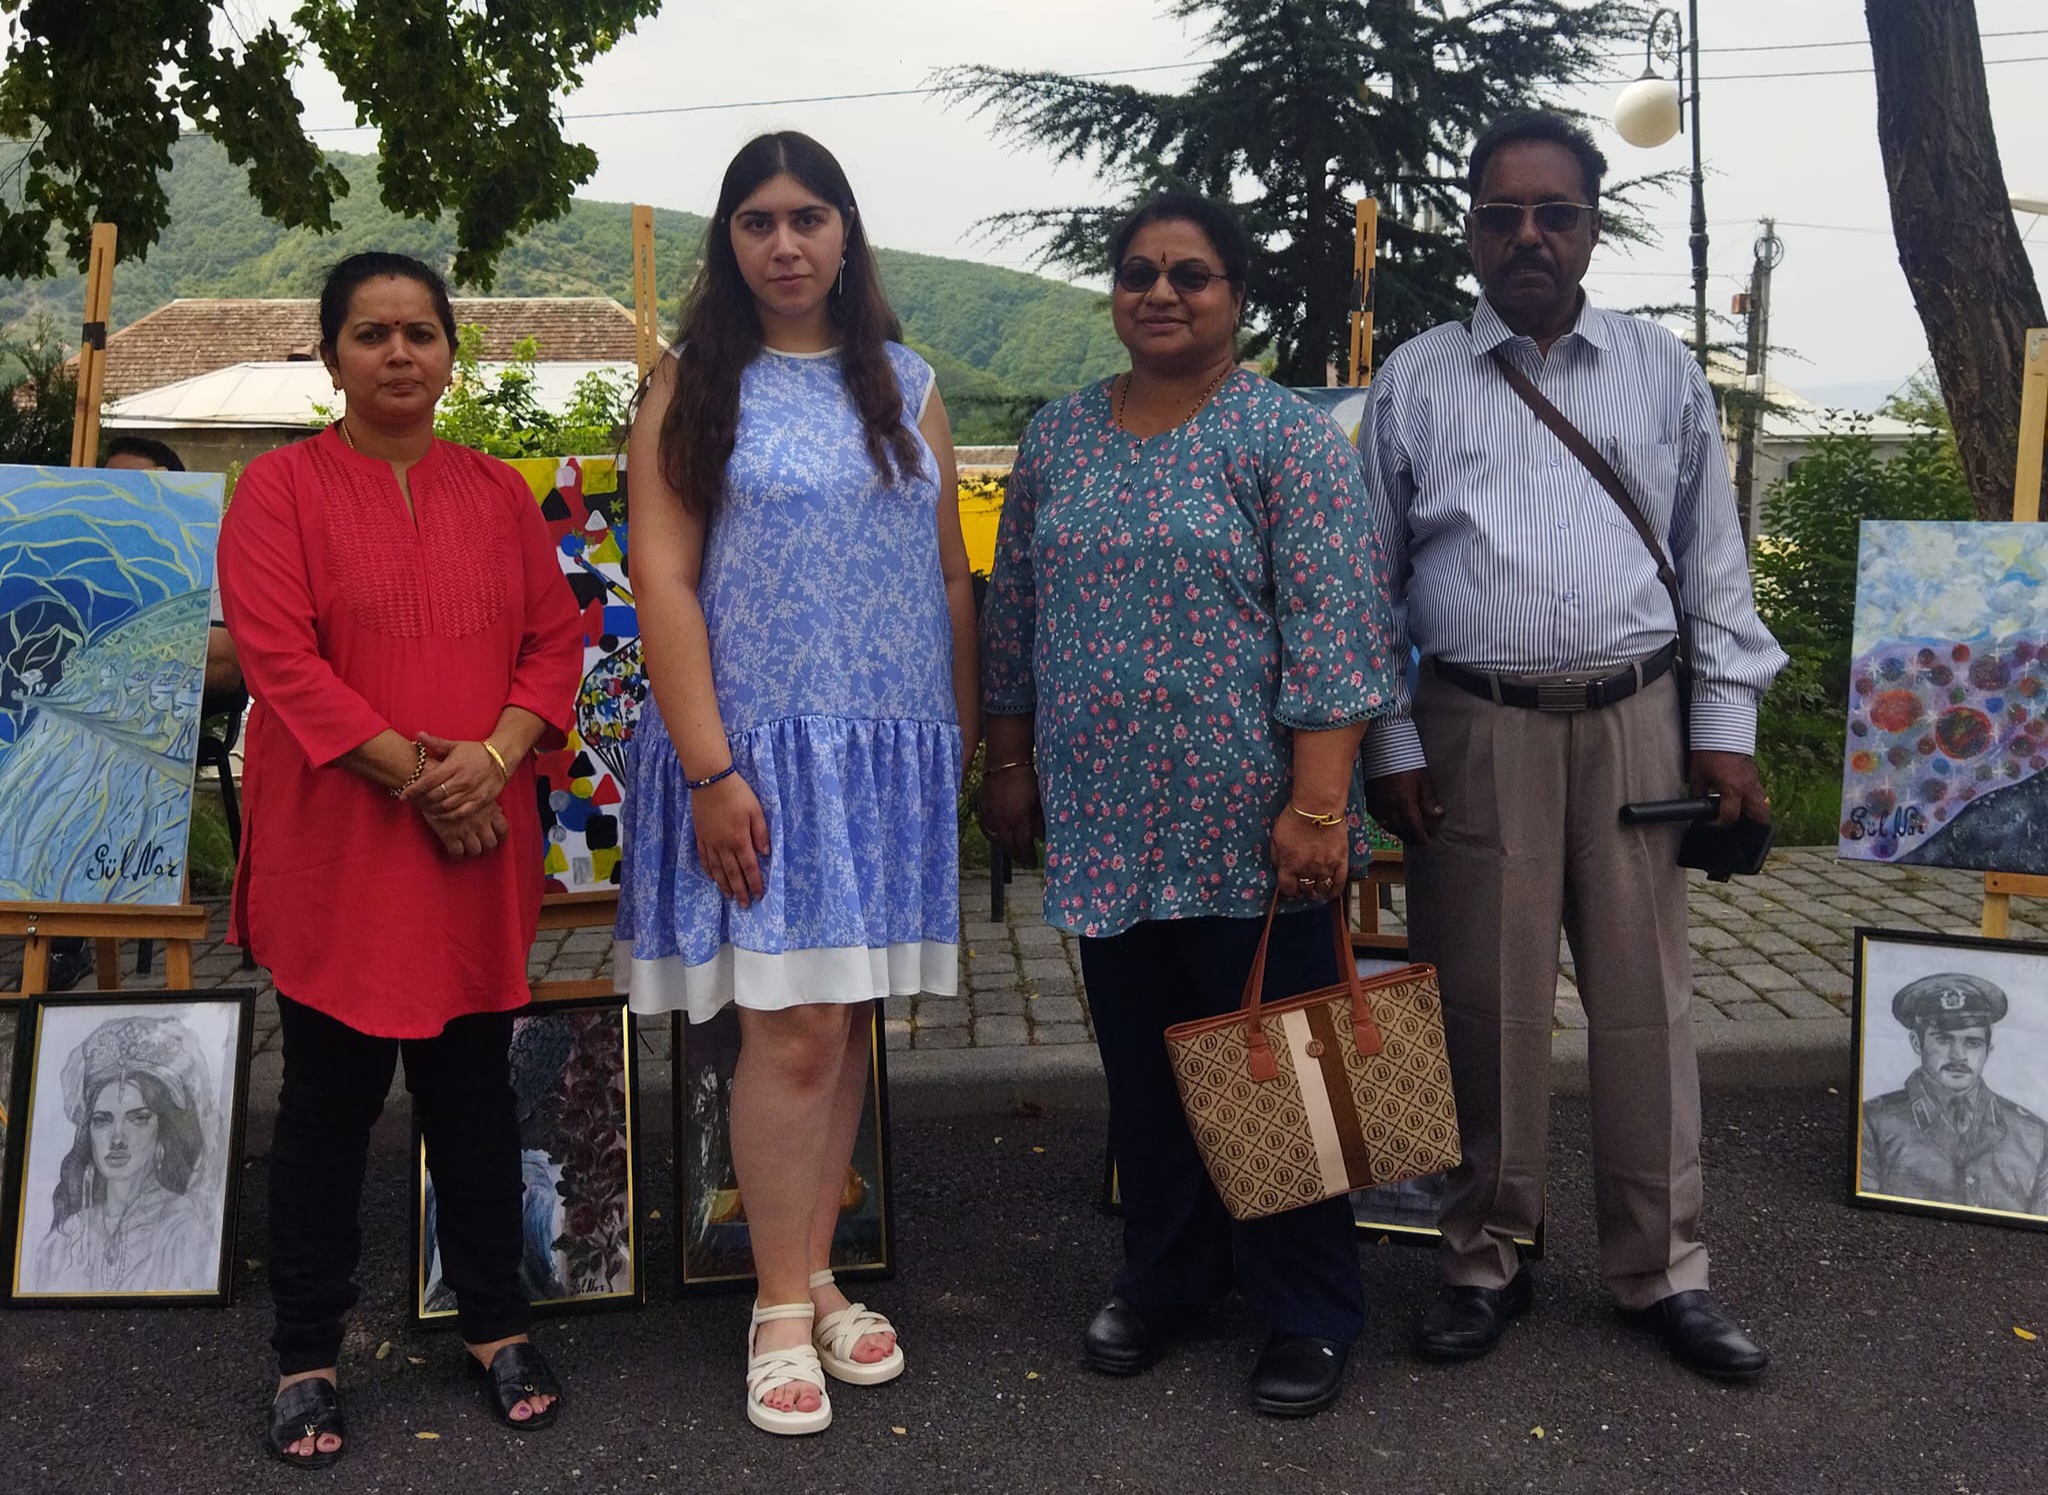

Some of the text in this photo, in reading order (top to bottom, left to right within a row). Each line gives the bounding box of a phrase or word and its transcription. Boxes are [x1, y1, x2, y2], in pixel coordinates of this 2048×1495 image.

[1395, 984, 1405, 998] B
[1419, 999, 1430, 1010] B
[1382, 1008, 1392, 1020] B
[1405, 1021, 1416, 1033] B
[1203, 1036, 1213, 1050] B
[1427, 1034, 1439, 1046] B
[1227, 1049, 1238, 1062] B
[1392, 1044, 1402, 1056] B
[1188, 1061, 1200, 1074] B
[1415, 1056, 1425, 1068] B
[1212, 1072, 1223, 1085] B
[1376, 1067, 1387, 1078] B
[1236, 1084, 1248, 1098] B
[1400, 1079, 1410, 1091] B
[1197, 1095, 1209, 1108] B
[1362, 1090, 1373, 1102] B
[1424, 1091, 1434, 1104] B
[1260, 1097, 1272, 1111] B
[1386, 1102, 1397, 1114] B
[1221, 1108, 1233, 1121] B
[1284, 1110, 1296, 1123] B
[1246, 1121, 1257, 1133] B
[1410, 1115, 1420, 1127] B
[1207, 1131, 1217, 1143] B
[1372, 1126, 1383, 1138] B
[1434, 1127, 1443, 1139] B
[1270, 1134, 1281, 1147] B
[1396, 1138, 1406, 1150] B
[1231, 1145, 1241, 1156] B
[1294, 1147, 1306, 1159] B
[1420, 1150, 1430, 1163] B
[1255, 1158, 1266, 1170] B
[1381, 1160, 1390, 1172] B
[1217, 1167, 1227, 1178] B
[1280, 1170, 1290, 1182] B
[1240, 1181, 1251, 1192] B
[1303, 1183, 1314, 1194] B
[1264, 1193, 1274, 1205] B
